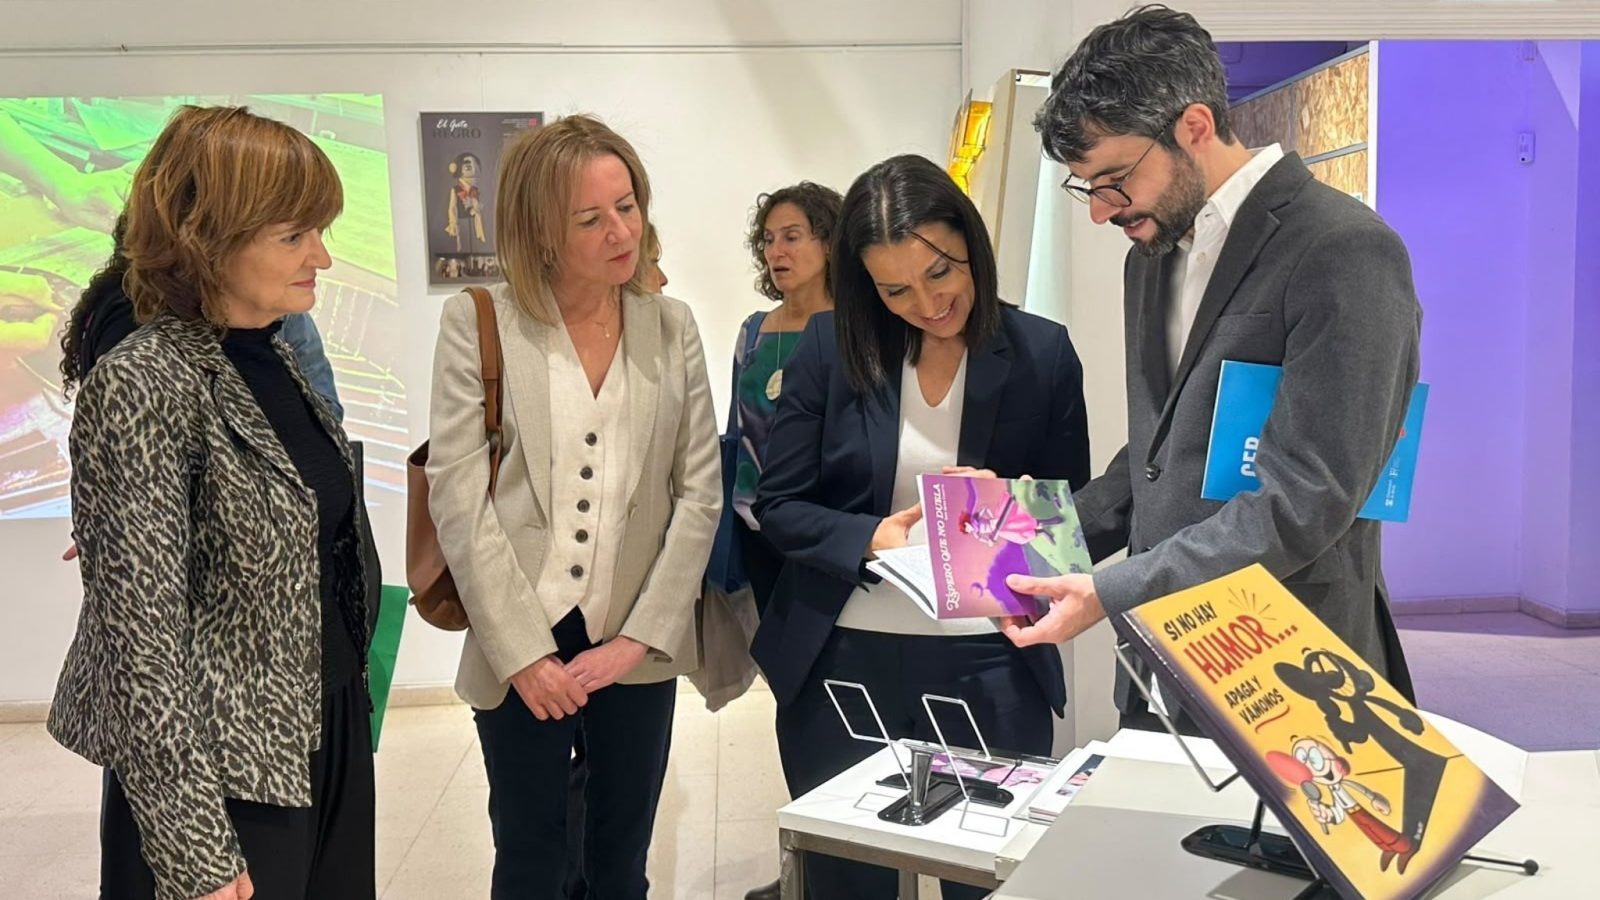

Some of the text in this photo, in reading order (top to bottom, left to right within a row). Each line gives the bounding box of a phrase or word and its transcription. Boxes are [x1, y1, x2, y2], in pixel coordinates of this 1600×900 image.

[436, 119, 448, 128] El
[932, 484, 944, 519] DUELA
[936, 521, 947, 537] NO
[940, 538, 952, 561] QUE
[1163, 601, 1218, 641] SI NO HAY
[1183, 615, 1298, 685] HUMOR...
[1224, 675, 1263, 708] APAGA Y
[1238, 688, 1285, 725] VÁMONOS
